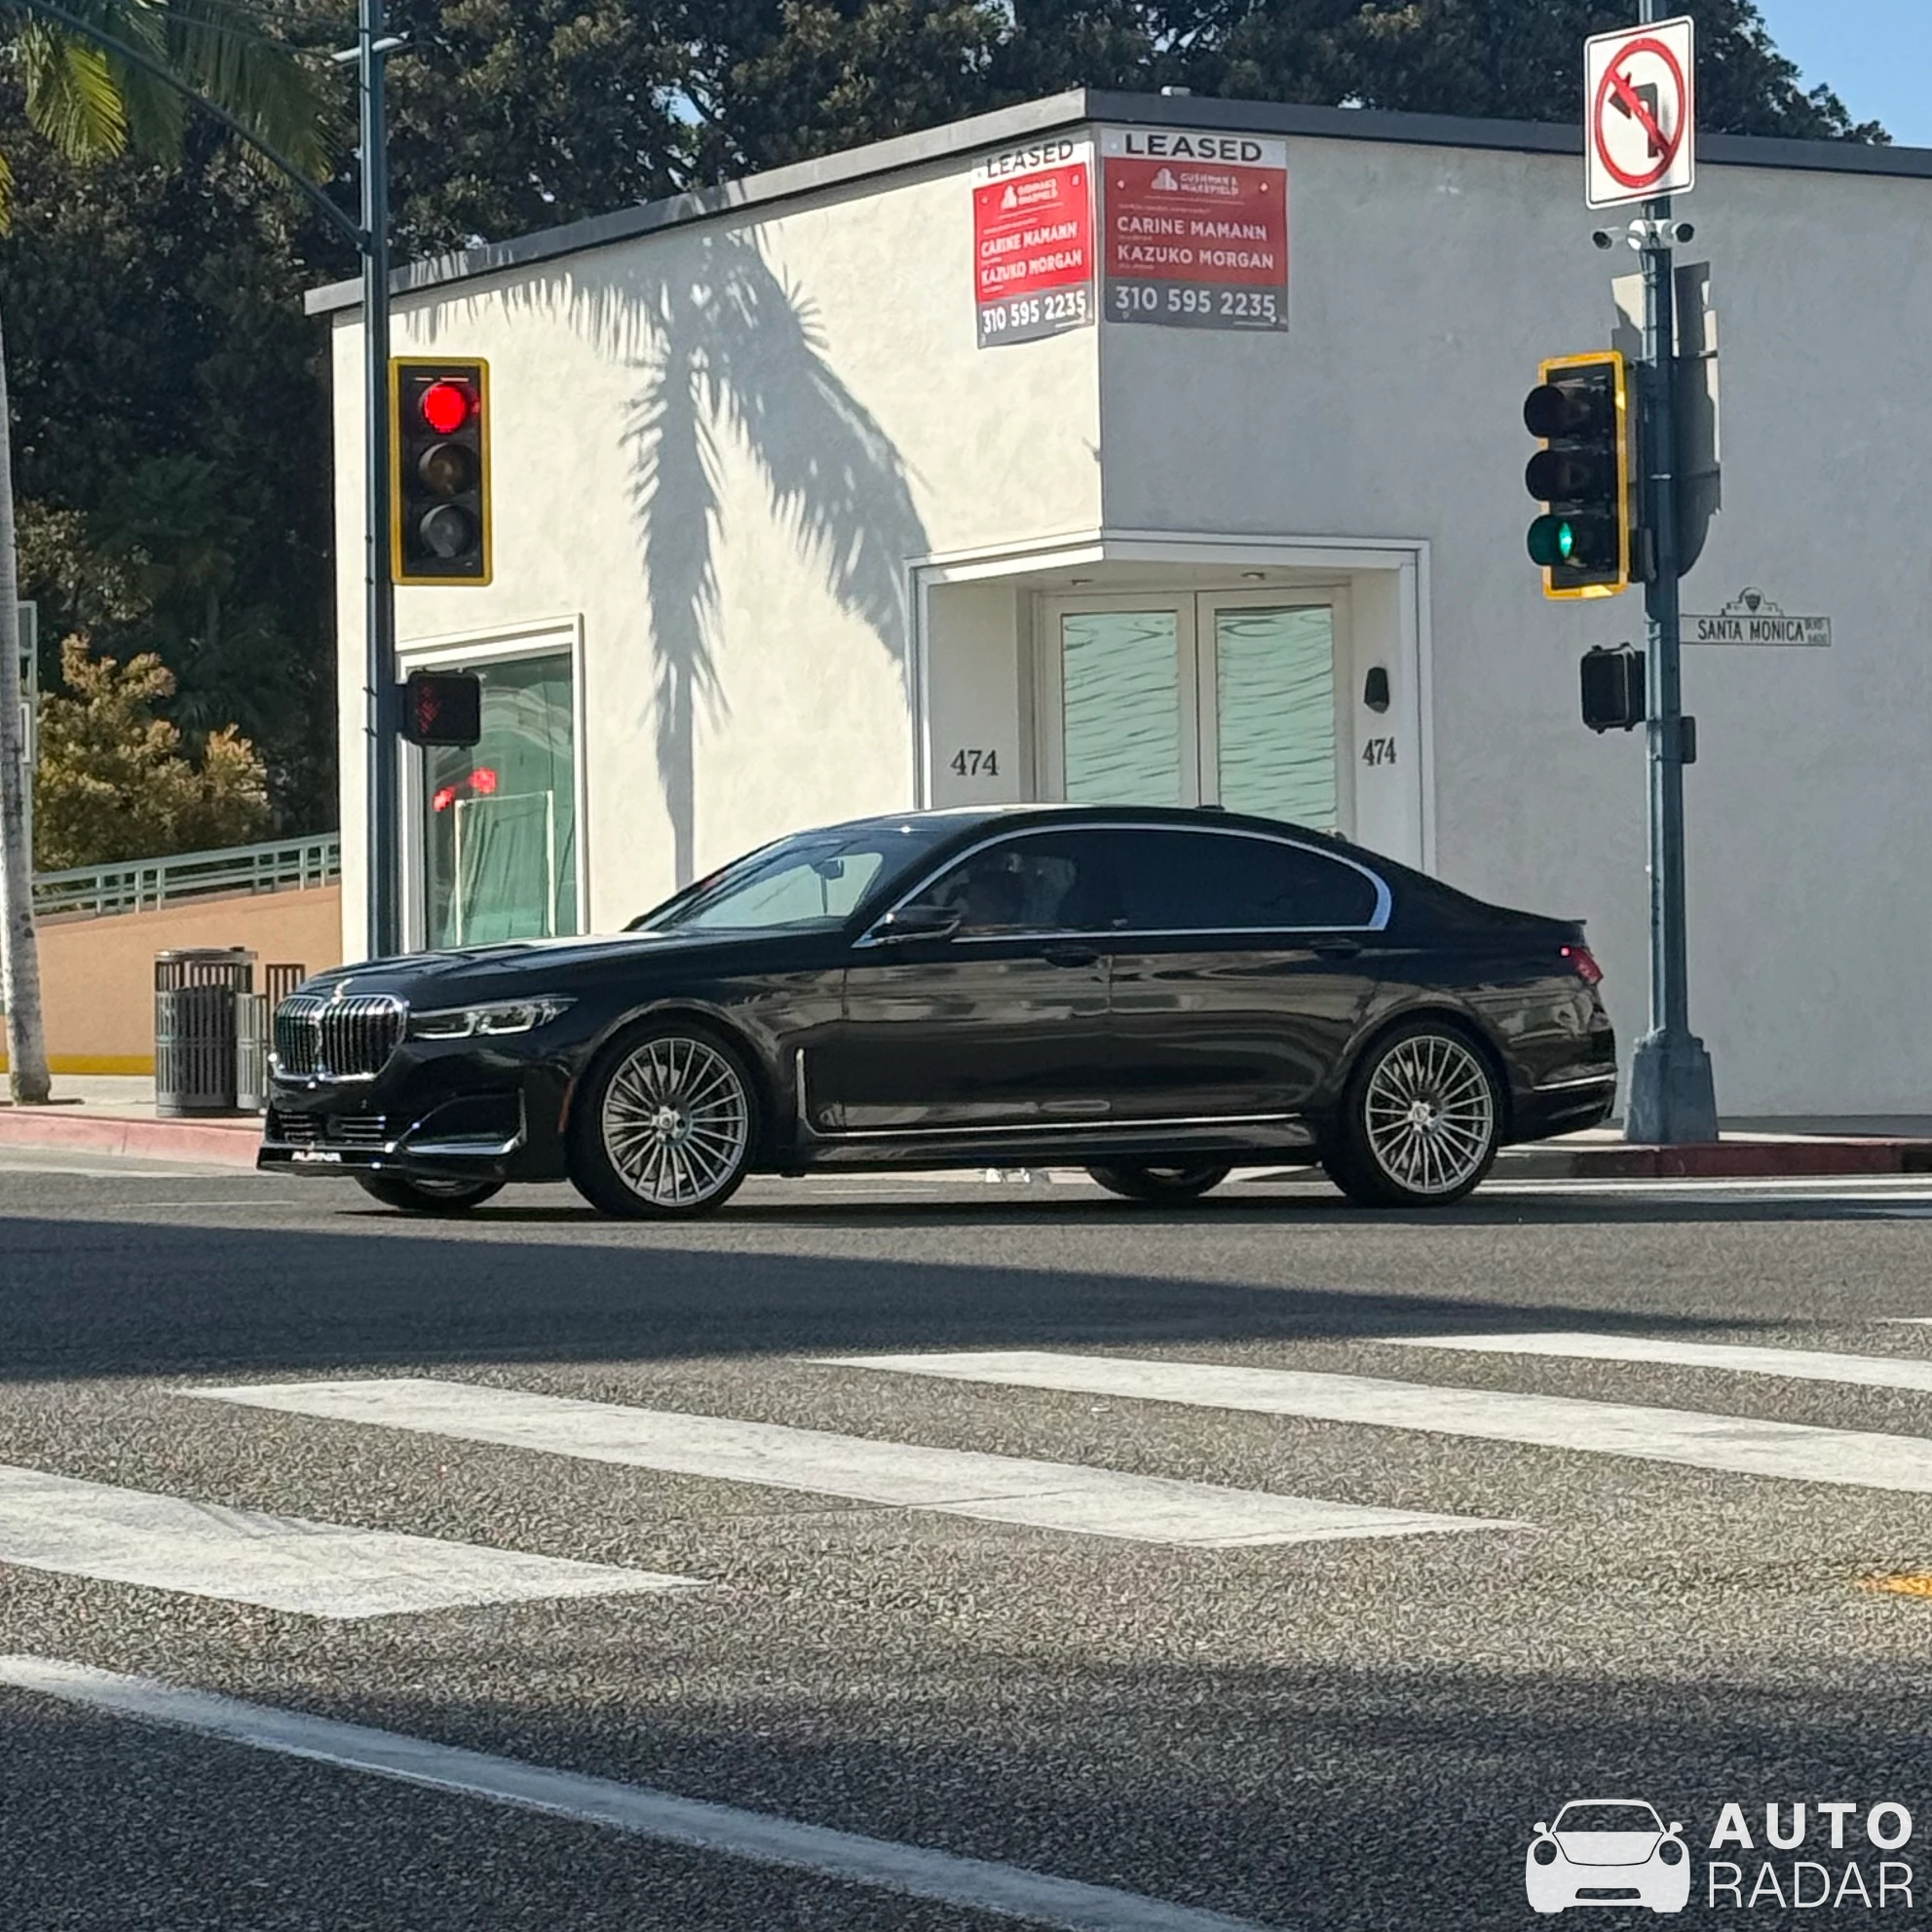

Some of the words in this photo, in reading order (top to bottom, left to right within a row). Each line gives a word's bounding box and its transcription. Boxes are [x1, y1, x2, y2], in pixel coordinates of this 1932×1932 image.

[987, 139, 1074, 178] LEASED
[1125, 133, 1263, 163] LEASED
[1117, 215, 1185, 235] CARINE
[1191, 220, 1268, 241] MAMANN
[981, 233, 1022, 258] CARINE
[1118, 245, 1193, 265] KAZUKO
[1198, 249, 1274, 269] MORGAN
[1028, 248, 1082, 275] MORGAN
[982, 306, 1007, 333] 310
[1010, 299, 1040, 327] 595
[1043, 290, 1086, 321] 2235
[1115, 285, 1157, 311] 310
[1167, 288, 1212, 314] 595
[1219, 291, 1276, 318] 2235
[1697, 619, 1743, 641] SANTA
[1749, 620, 1804, 642] MONICA
[950, 748, 1000, 777] 474
[1362, 737, 1397, 767] 474
